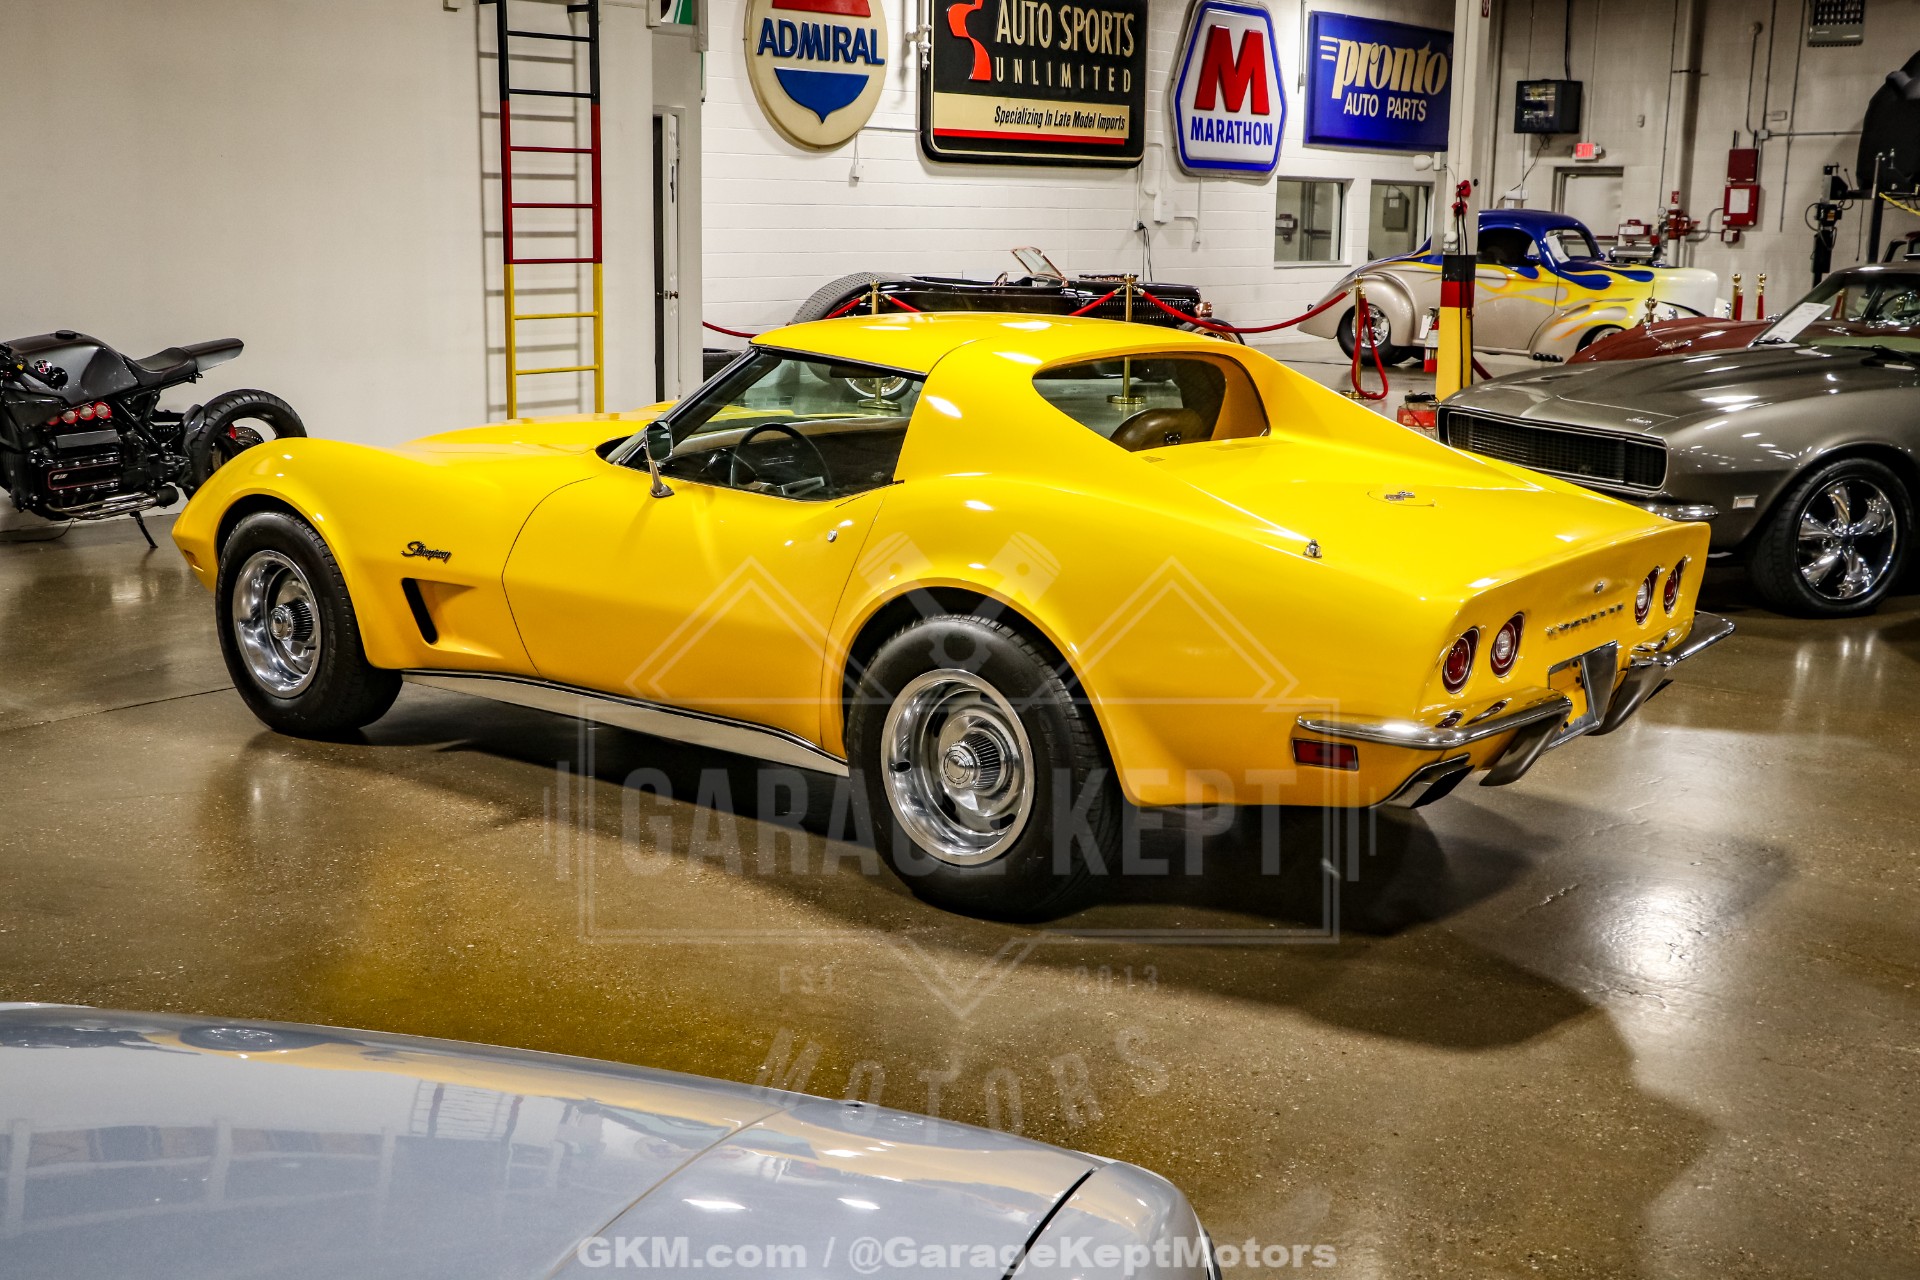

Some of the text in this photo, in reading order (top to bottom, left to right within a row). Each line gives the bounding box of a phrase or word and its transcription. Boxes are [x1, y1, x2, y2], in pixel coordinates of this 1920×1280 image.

[757, 17, 885, 65] ADMIRAL
[996, 0, 1135, 57] AUTO SPORTS
[995, 56, 1131, 93] UNLIMITED
[1194, 24, 1270, 115] M
[1331, 37, 1449, 99] pronto
[994, 105, 1126, 132] Specializing In Late Model Imports
[1343, 92, 1427, 122] AUTO PARTS
[1190, 116, 1273, 146] MARATHON
